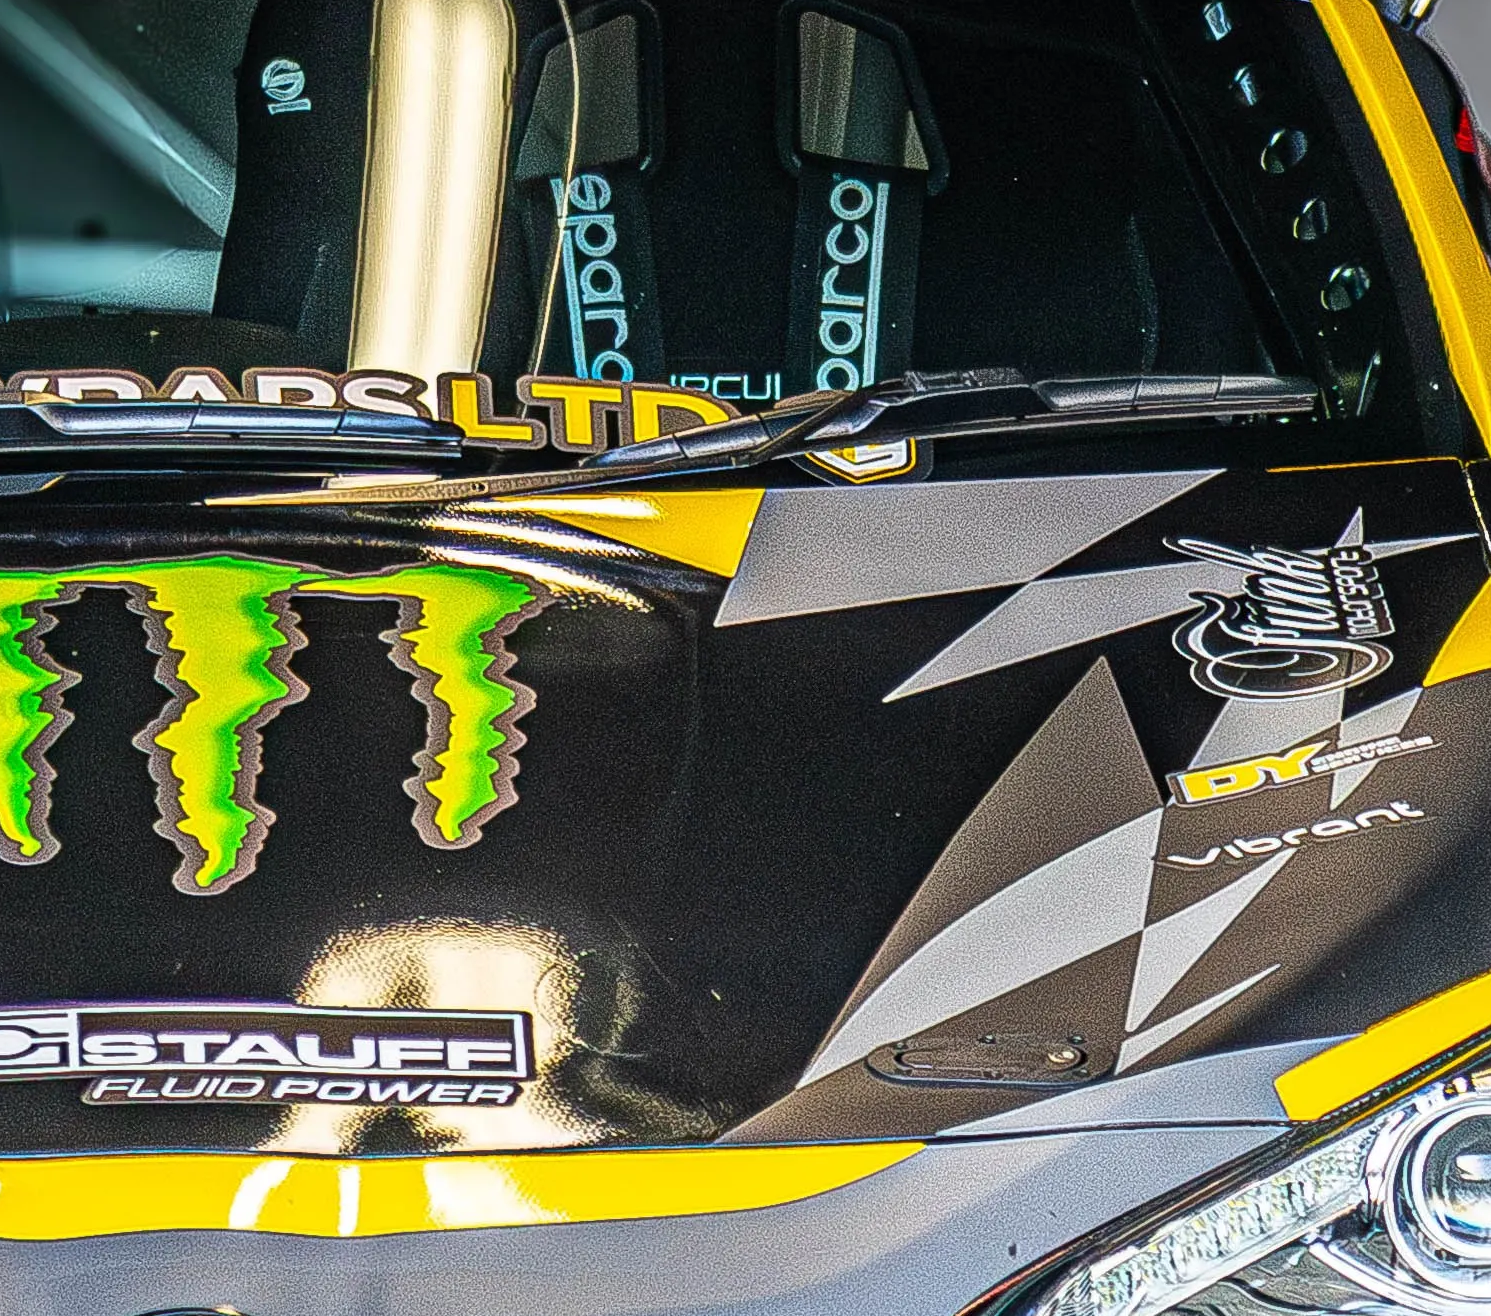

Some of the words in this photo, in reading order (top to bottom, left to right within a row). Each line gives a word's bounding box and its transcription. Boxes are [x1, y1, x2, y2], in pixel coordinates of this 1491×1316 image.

[557, 173, 634, 381] sparc
[817, 179, 873, 392] parco
[1178, 740, 1332, 803] DY
[81, 1031, 513, 1070] STAUFF
[90, 1076, 265, 1101] FLUID
[271, 1079, 514, 1105] POWER
